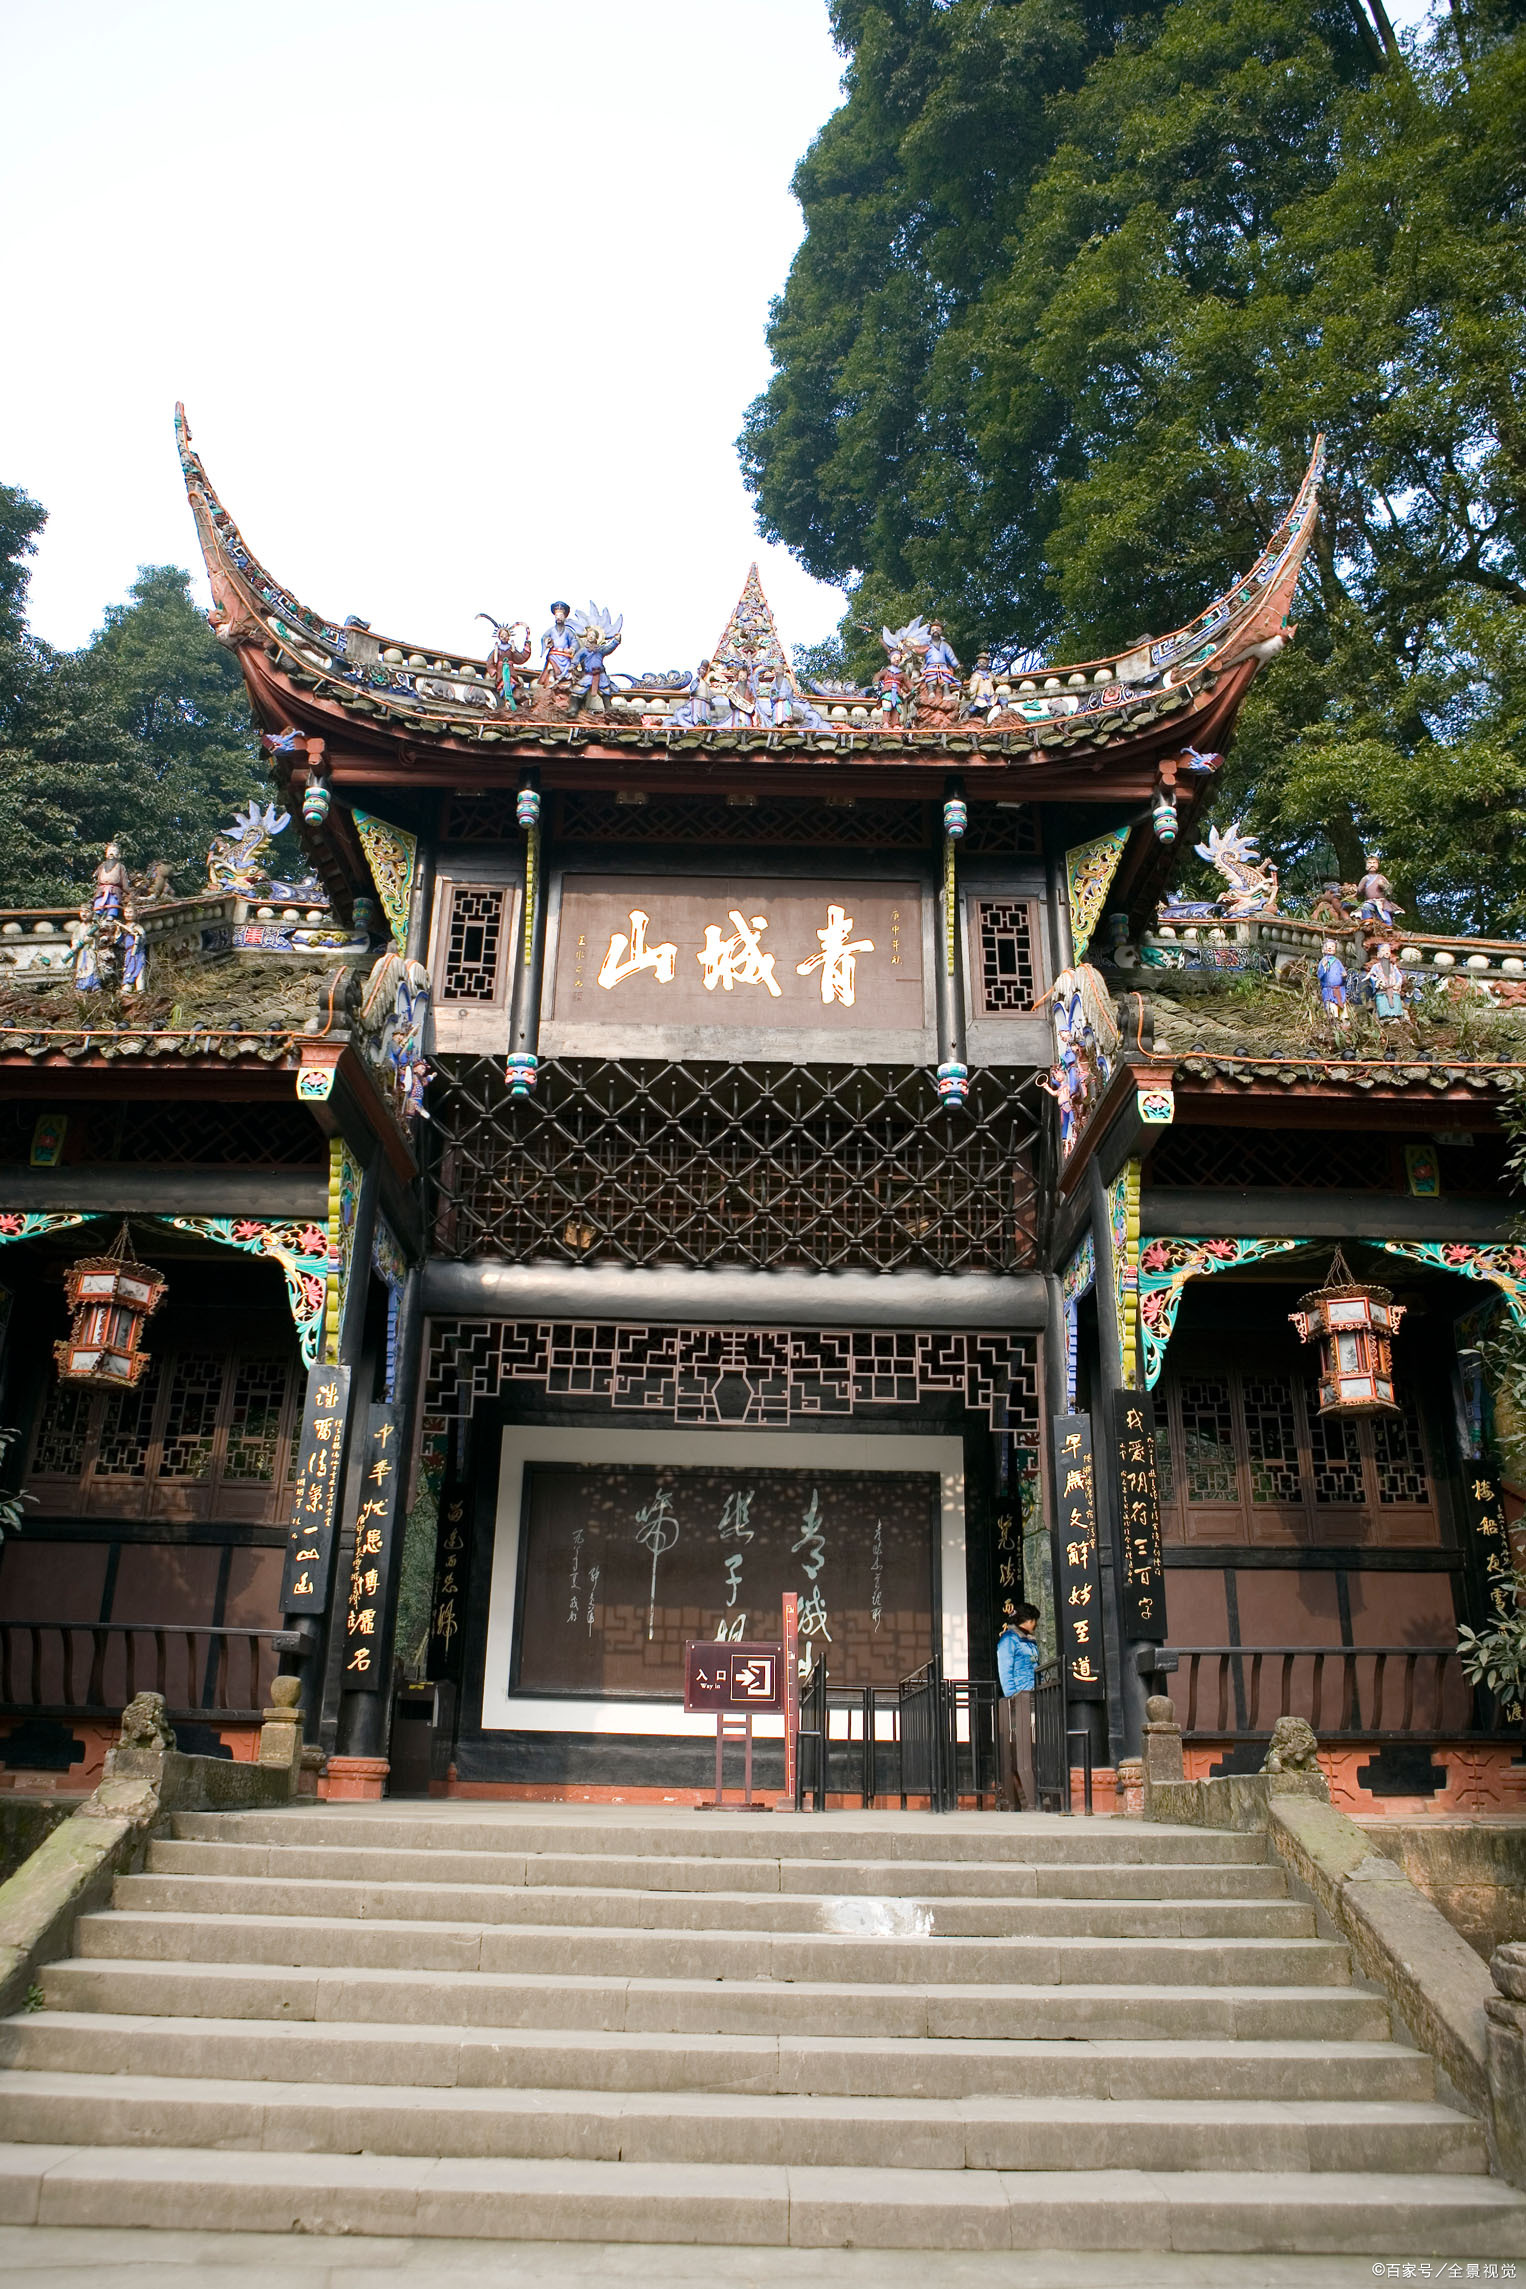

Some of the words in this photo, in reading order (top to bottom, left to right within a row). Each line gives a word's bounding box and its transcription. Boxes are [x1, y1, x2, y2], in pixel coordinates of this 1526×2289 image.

[597, 904, 874, 1007] 青城山
[696, 1668, 727, 1681] 入口
